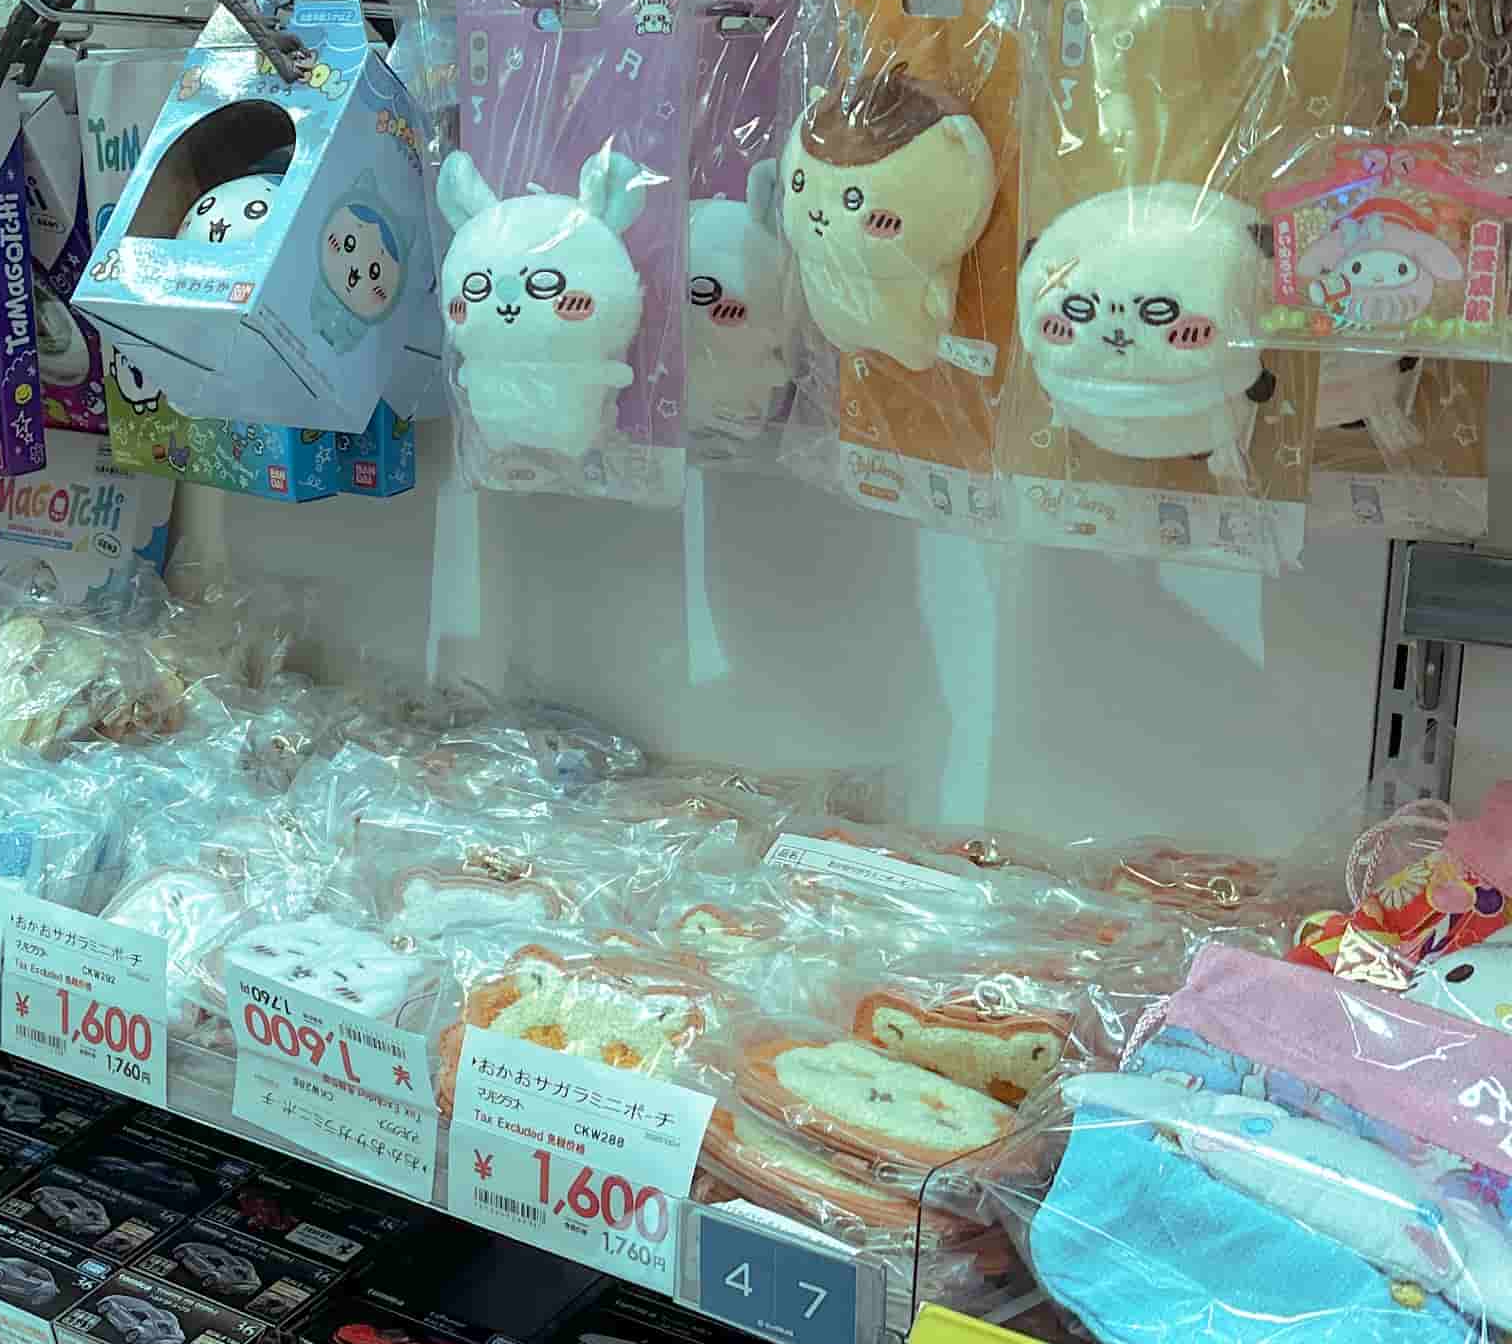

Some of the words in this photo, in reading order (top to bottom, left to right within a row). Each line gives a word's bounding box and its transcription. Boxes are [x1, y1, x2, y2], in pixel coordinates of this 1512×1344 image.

[56, 988, 152, 1062] 1,600
[244, 1002, 362, 1084] 1,600
[473, 1108, 494, 1124] Tax
[497, 1115, 546, 1143] Excluded
[479, 1059, 676, 1128] おかおサガラミニポーチ
[473, 1148, 494, 1181] ¥
[533, 1149, 669, 1245] 1,600
[600, 1232, 666, 1274] 1,760円
[724, 1262, 754, 1298] 4
[798, 1280, 828, 1320] 7
